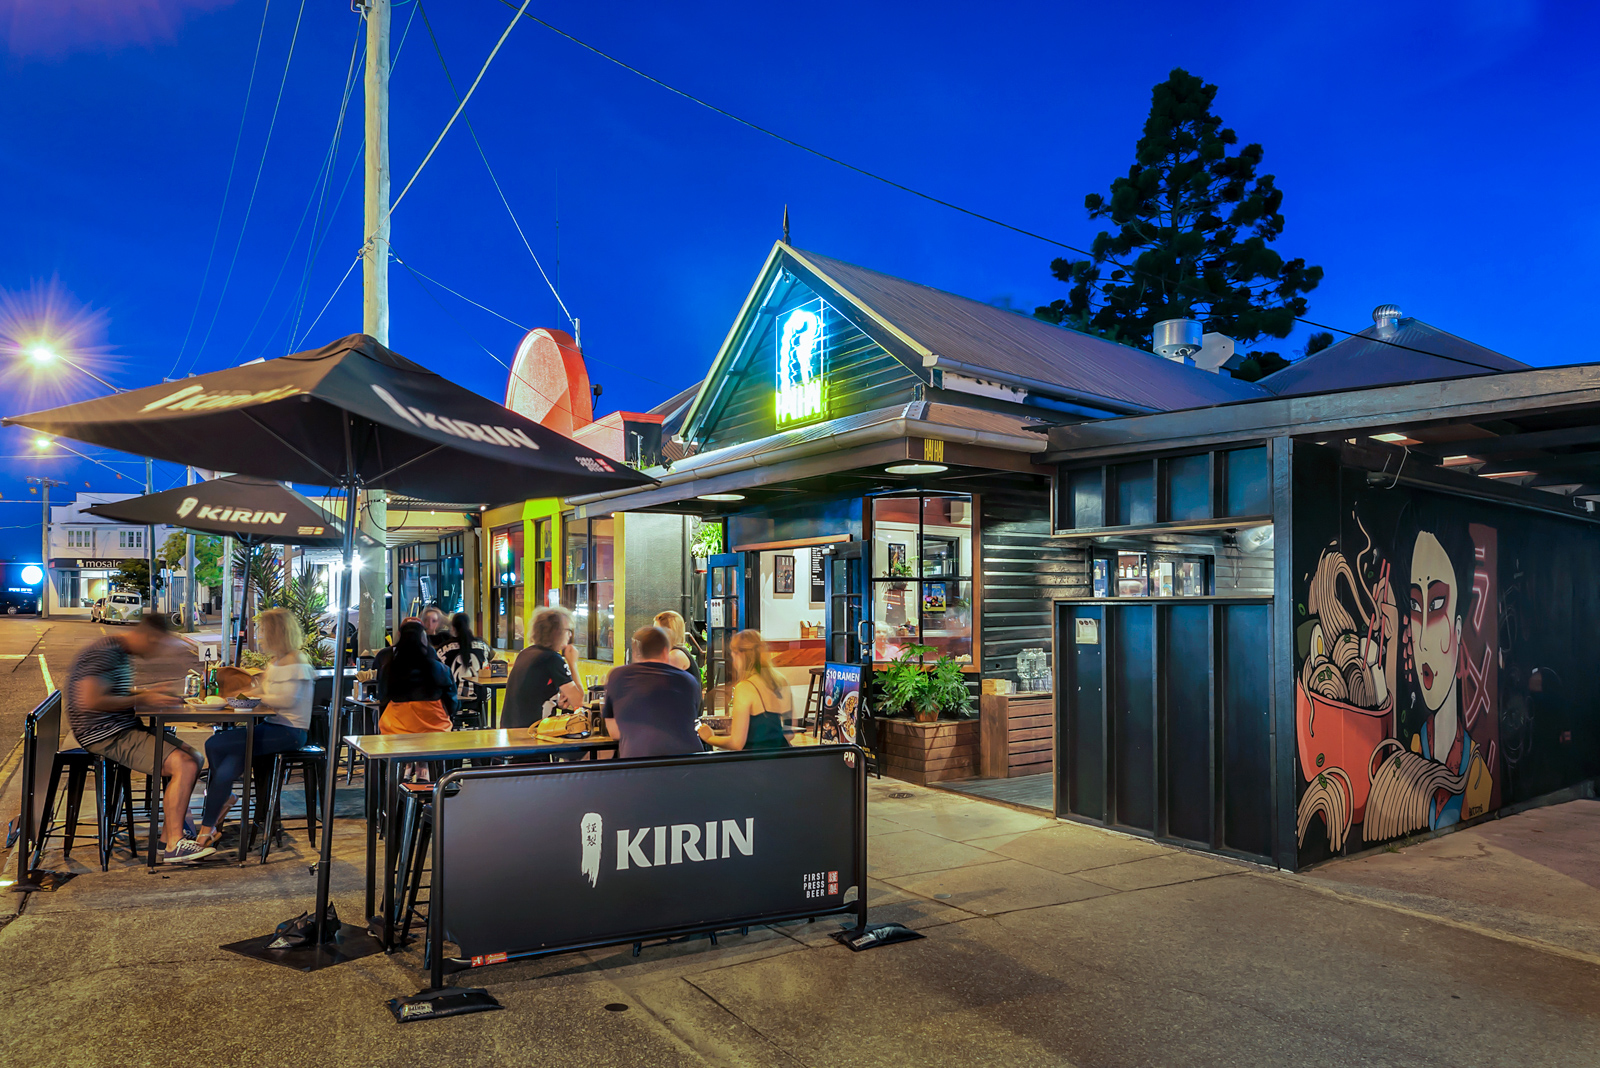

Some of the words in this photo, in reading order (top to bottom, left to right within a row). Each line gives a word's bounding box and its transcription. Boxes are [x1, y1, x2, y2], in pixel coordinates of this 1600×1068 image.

[407, 406, 540, 450] KIRIN
[196, 505, 288, 525] KIRIN
[86, 559, 122, 568] mosaic
[204, 648, 211, 658] 4
[826, 669, 836, 680] $10
[837, 670, 860, 682] RAMEN
[616, 817, 754, 870] KIRIN
[803, 872, 826, 882] FIRST
[803, 881, 825, 891] PRESS
[806, 889, 825, 899] BEER
